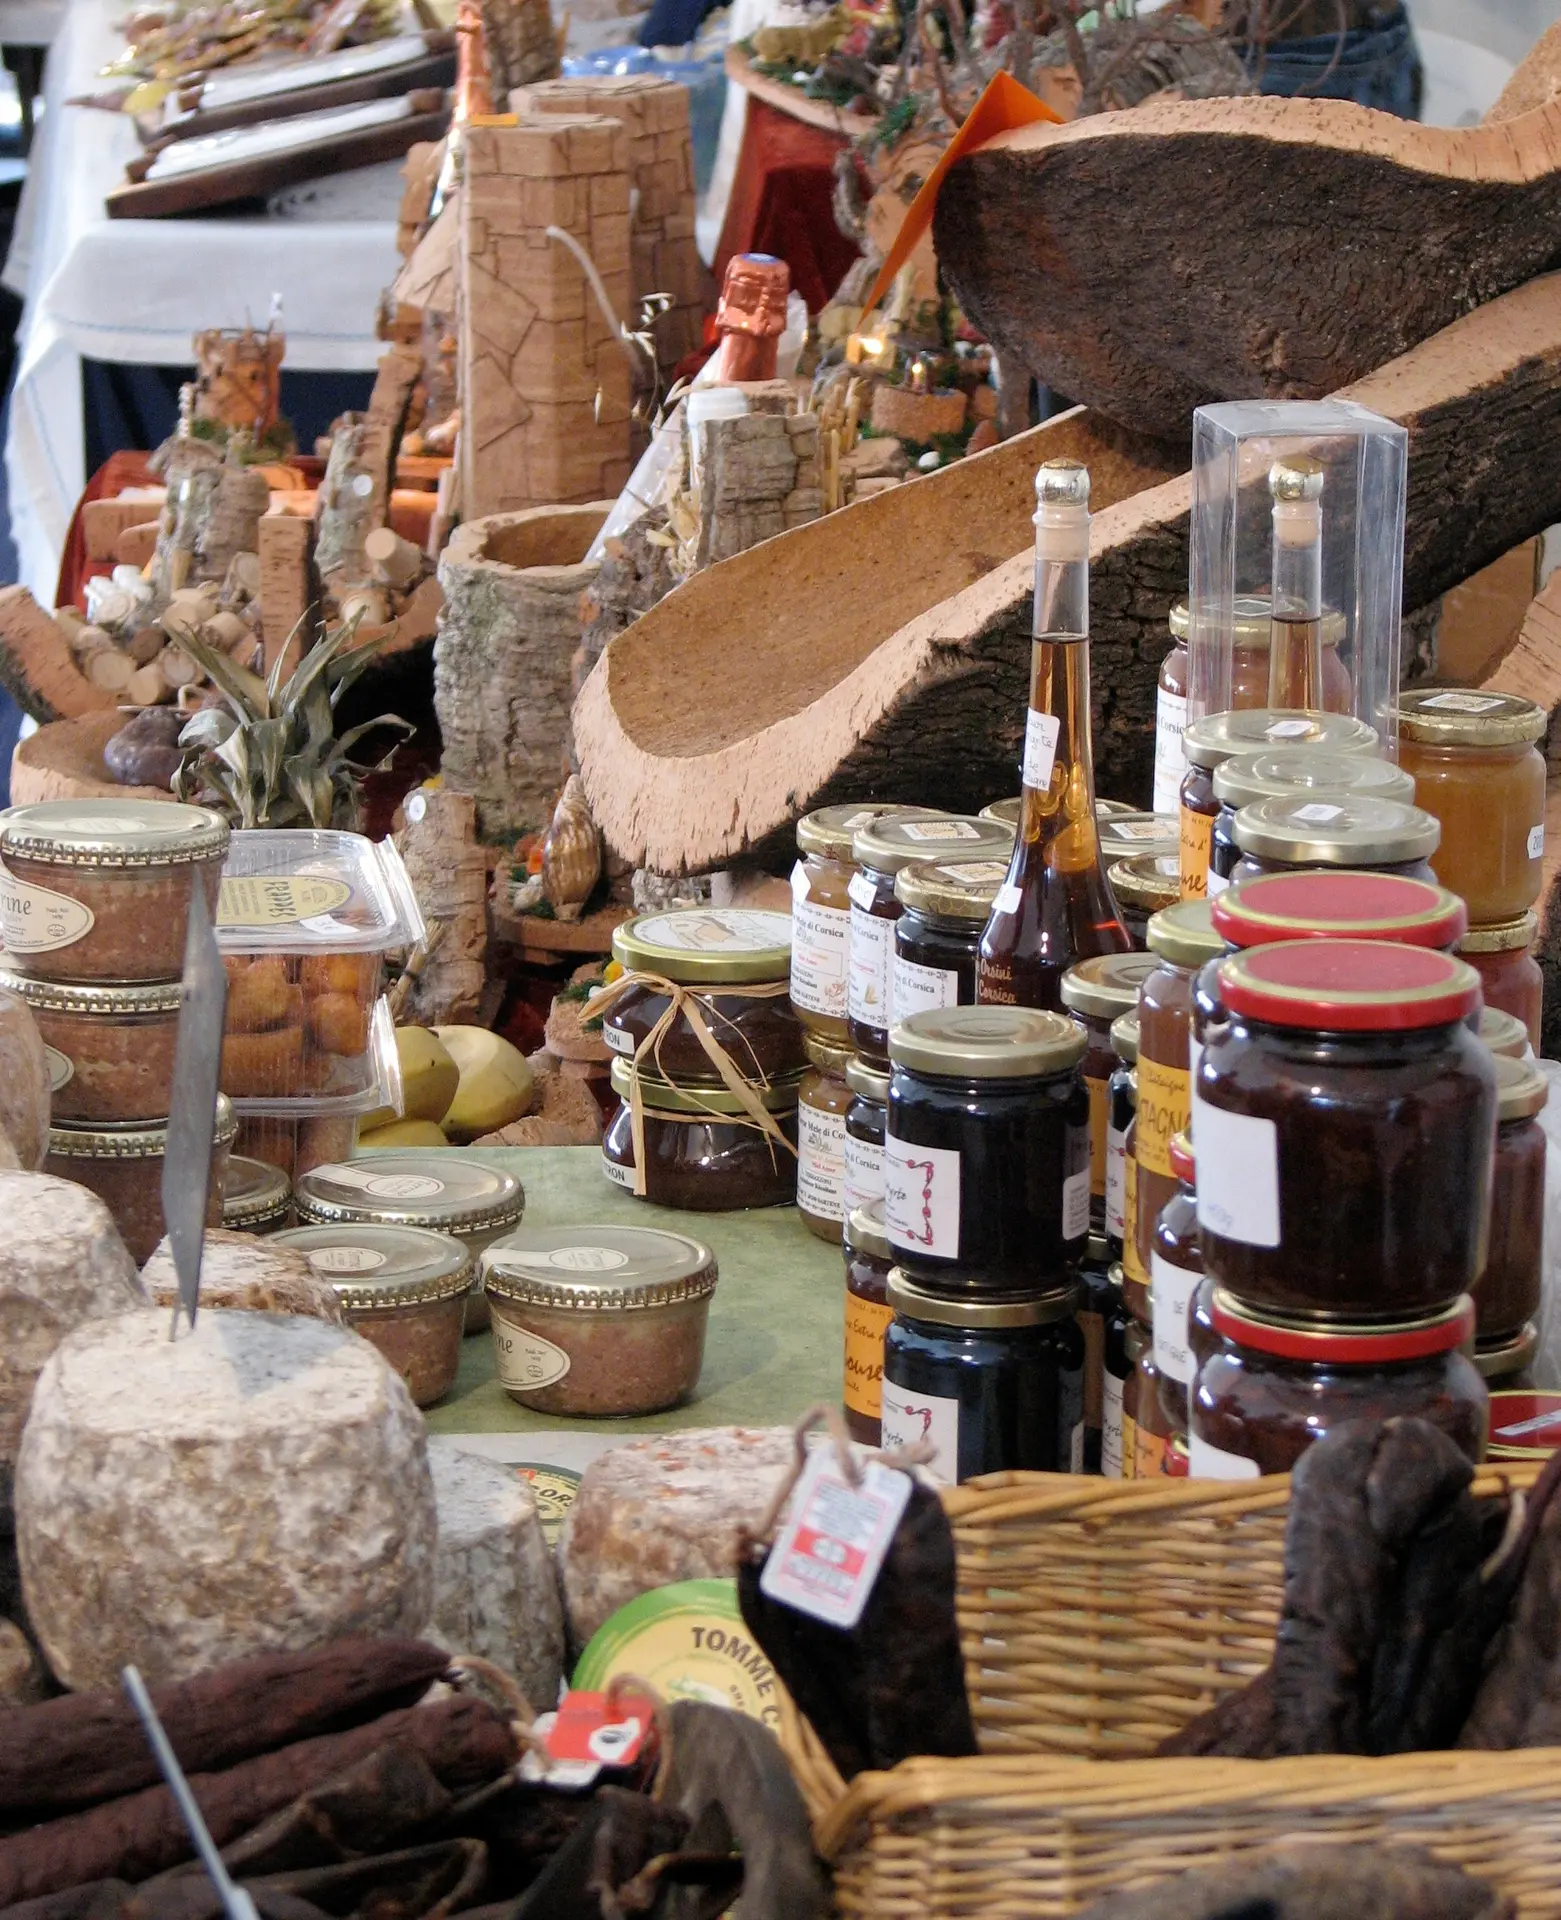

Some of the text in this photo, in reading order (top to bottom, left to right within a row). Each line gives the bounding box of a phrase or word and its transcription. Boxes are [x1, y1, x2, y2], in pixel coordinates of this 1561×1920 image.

[814, 923, 845, 939] Corsica
[858, 926, 879, 942] Corsica
[980, 958, 1013, 980] Orsini
[907, 979, 935, 994] Corsica
[979, 979, 1017, 1004] Corsica
[823, 1127, 830, 1136] di
[855, 1155, 880, 1171] Corsica
[691, 1626, 777, 1699] TOMME
